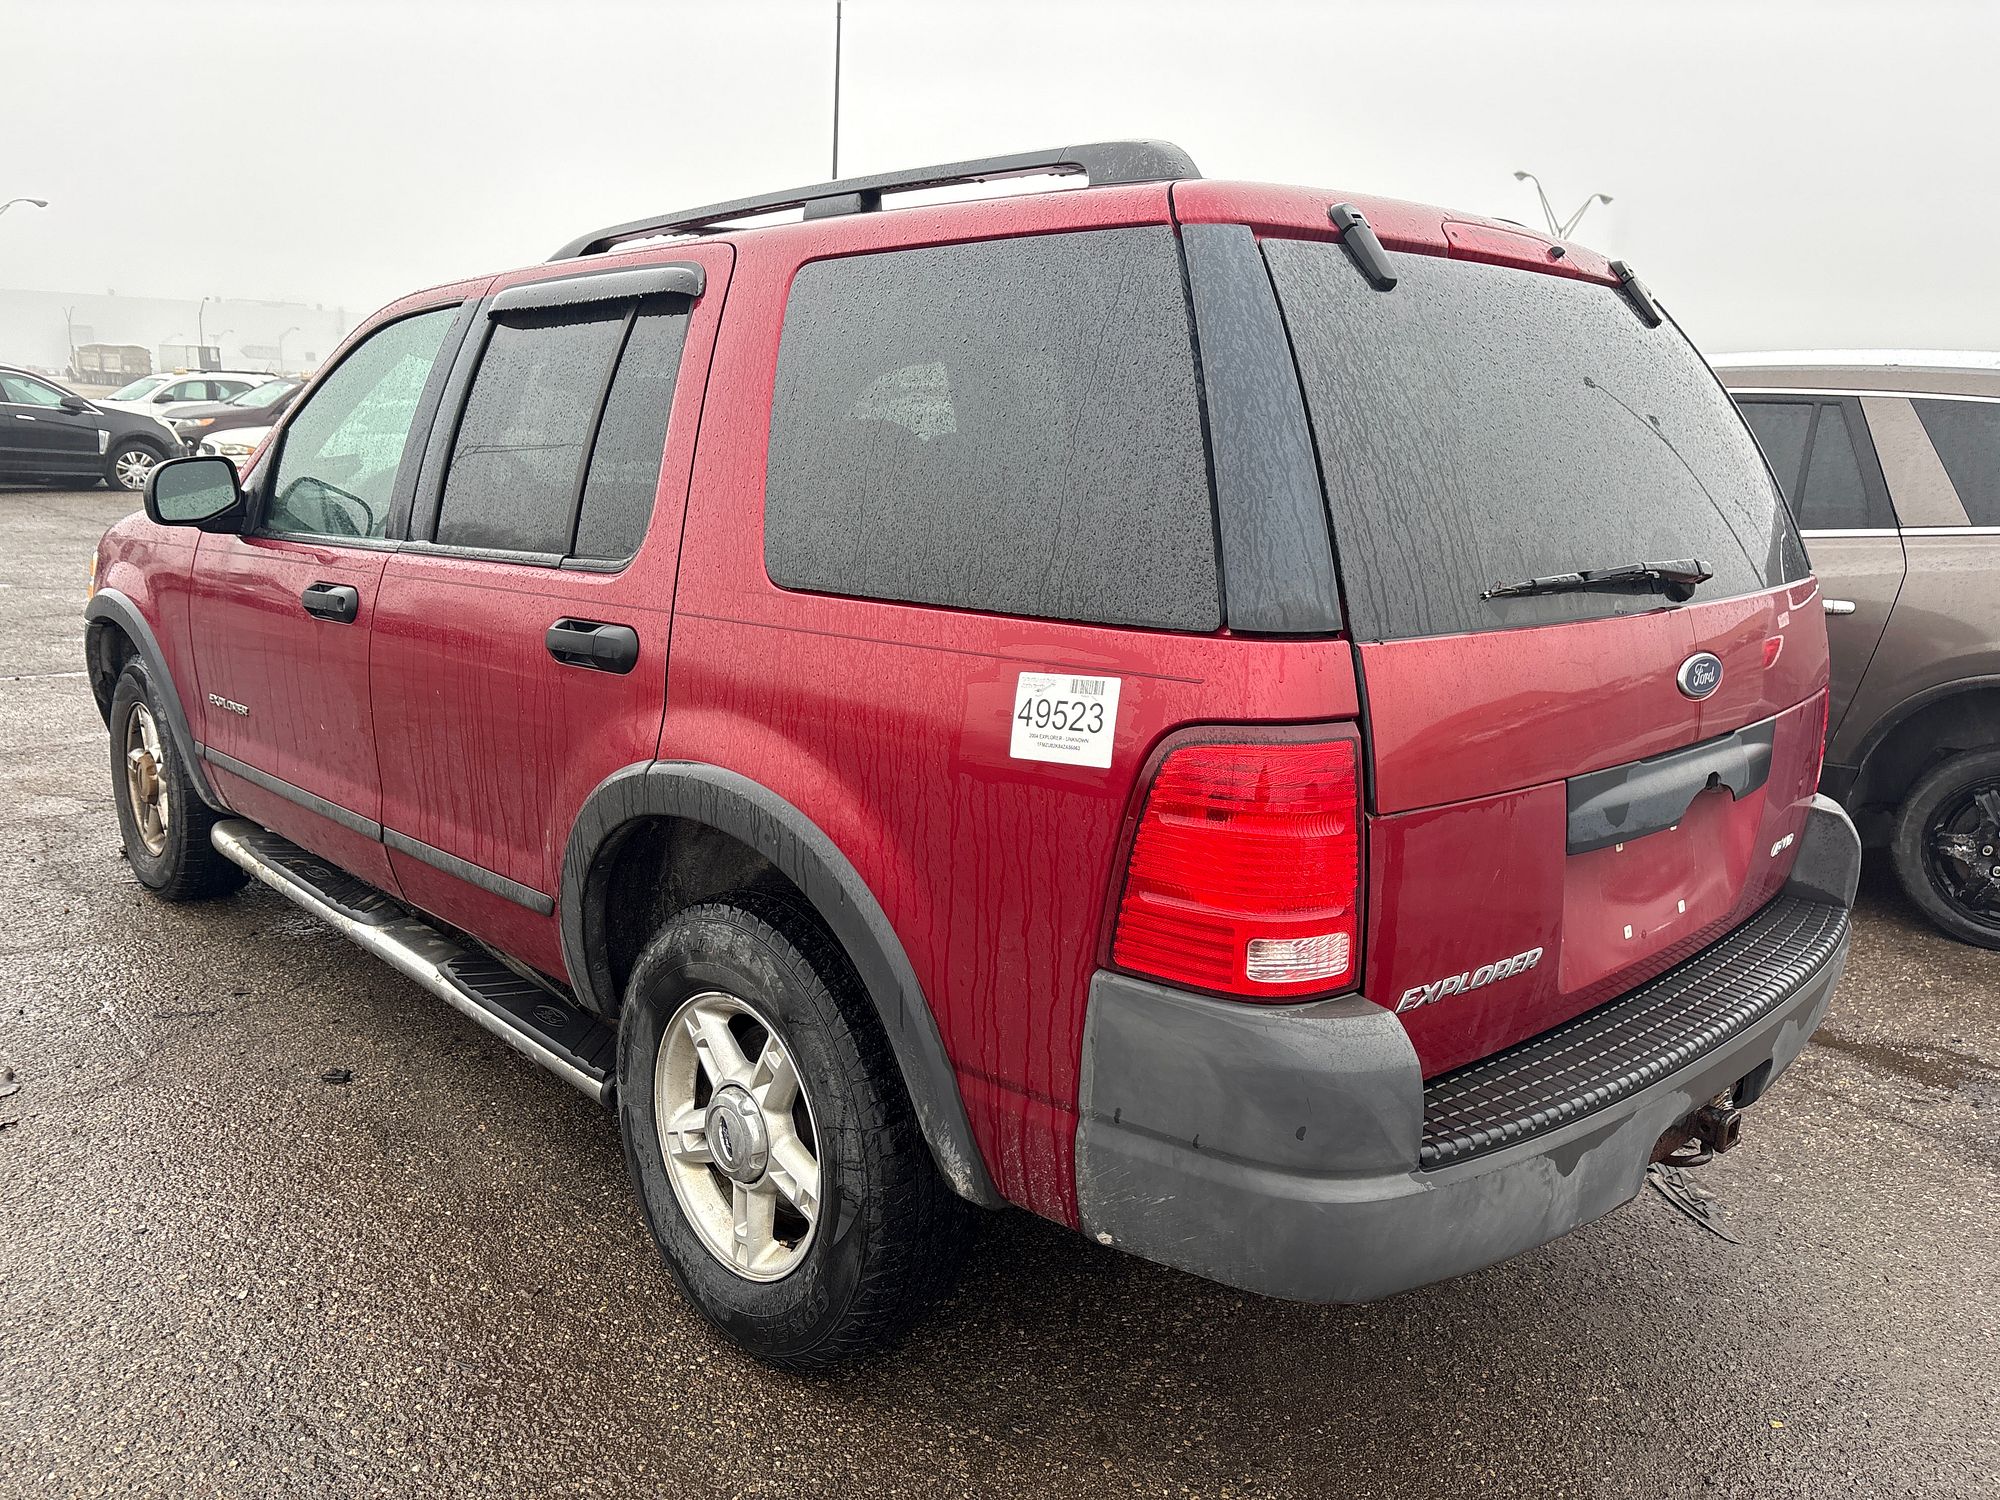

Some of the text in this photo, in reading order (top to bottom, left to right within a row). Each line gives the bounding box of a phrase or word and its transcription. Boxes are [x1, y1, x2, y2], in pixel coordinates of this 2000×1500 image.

[1693, 662, 1715, 687] Ford
[209, 693, 249, 716] EXPLORER
[1018, 697, 1104, 734] 49523
[1395, 946, 1545, 1014] EXPLORER
